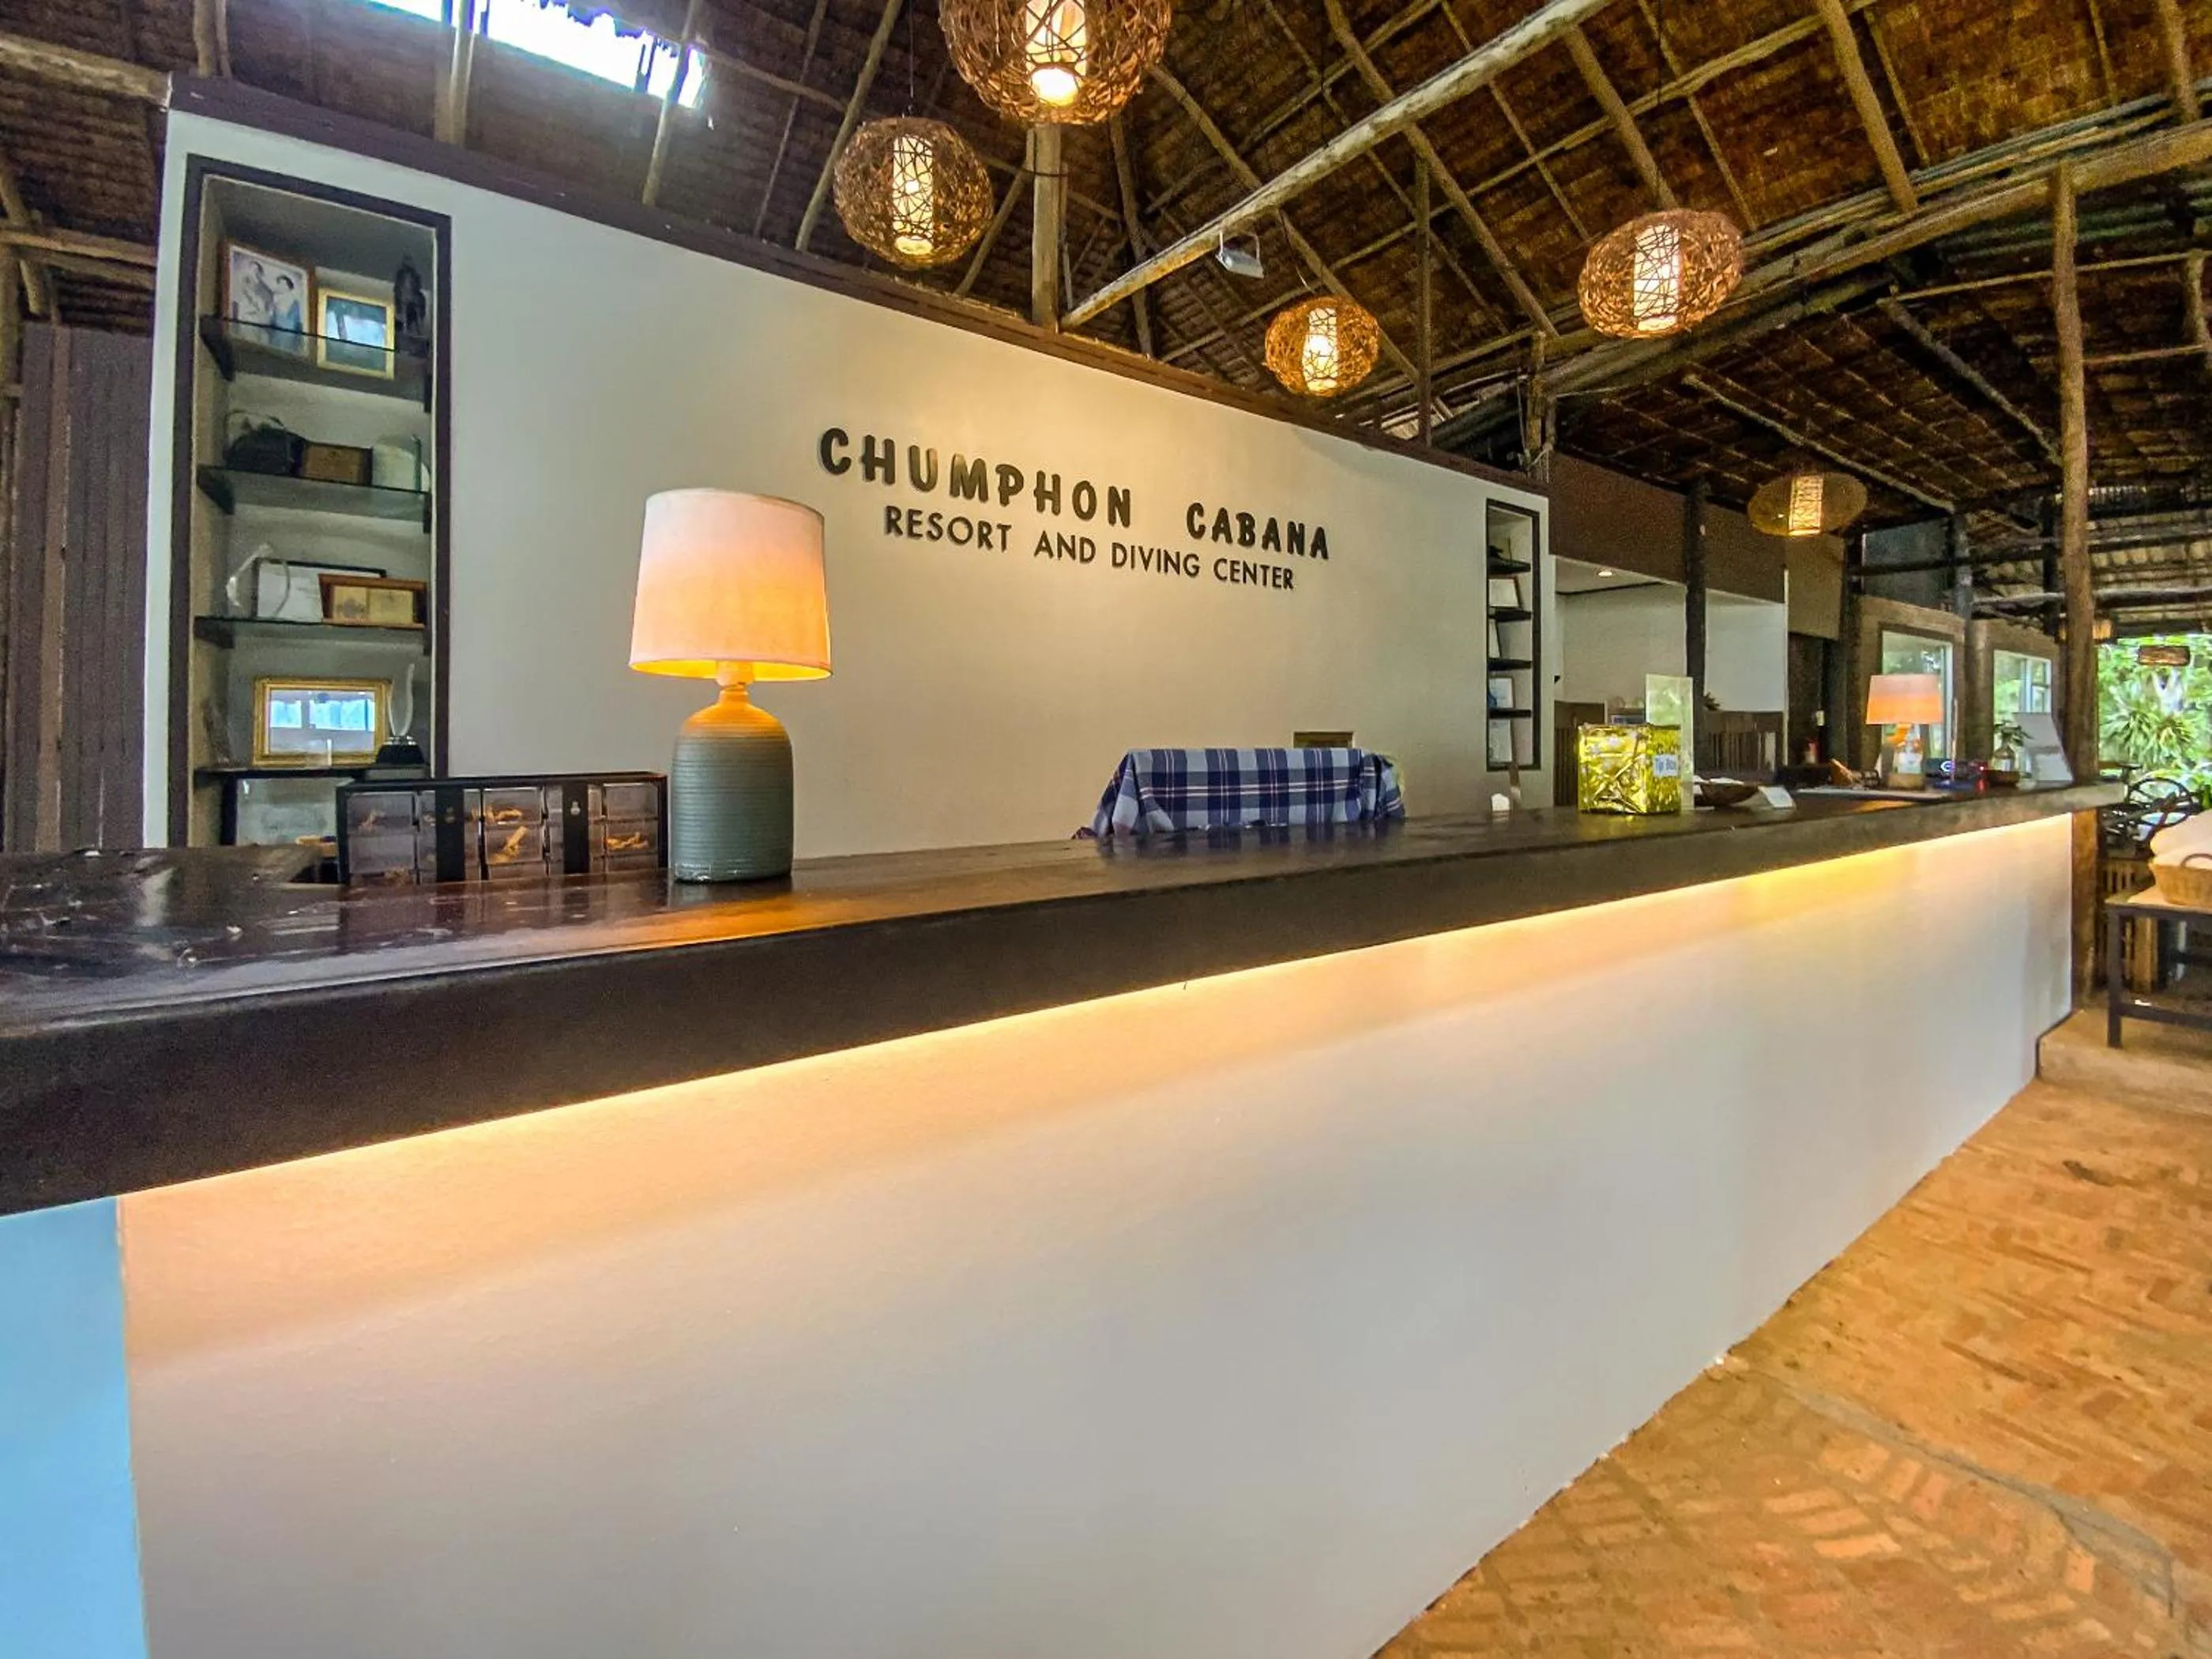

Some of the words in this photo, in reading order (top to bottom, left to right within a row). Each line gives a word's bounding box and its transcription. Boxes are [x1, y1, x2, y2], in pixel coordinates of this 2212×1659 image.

[819, 427, 1131, 529] CHUMPHON
[1187, 502, 1330, 561] CABANA
[885, 506, 1012, 553] RESORT
[1034, 531, 1097, 564] AND
[1112, 543, 1201, 578] DIVING
[1213, 558, 1294, 590] CENTER
